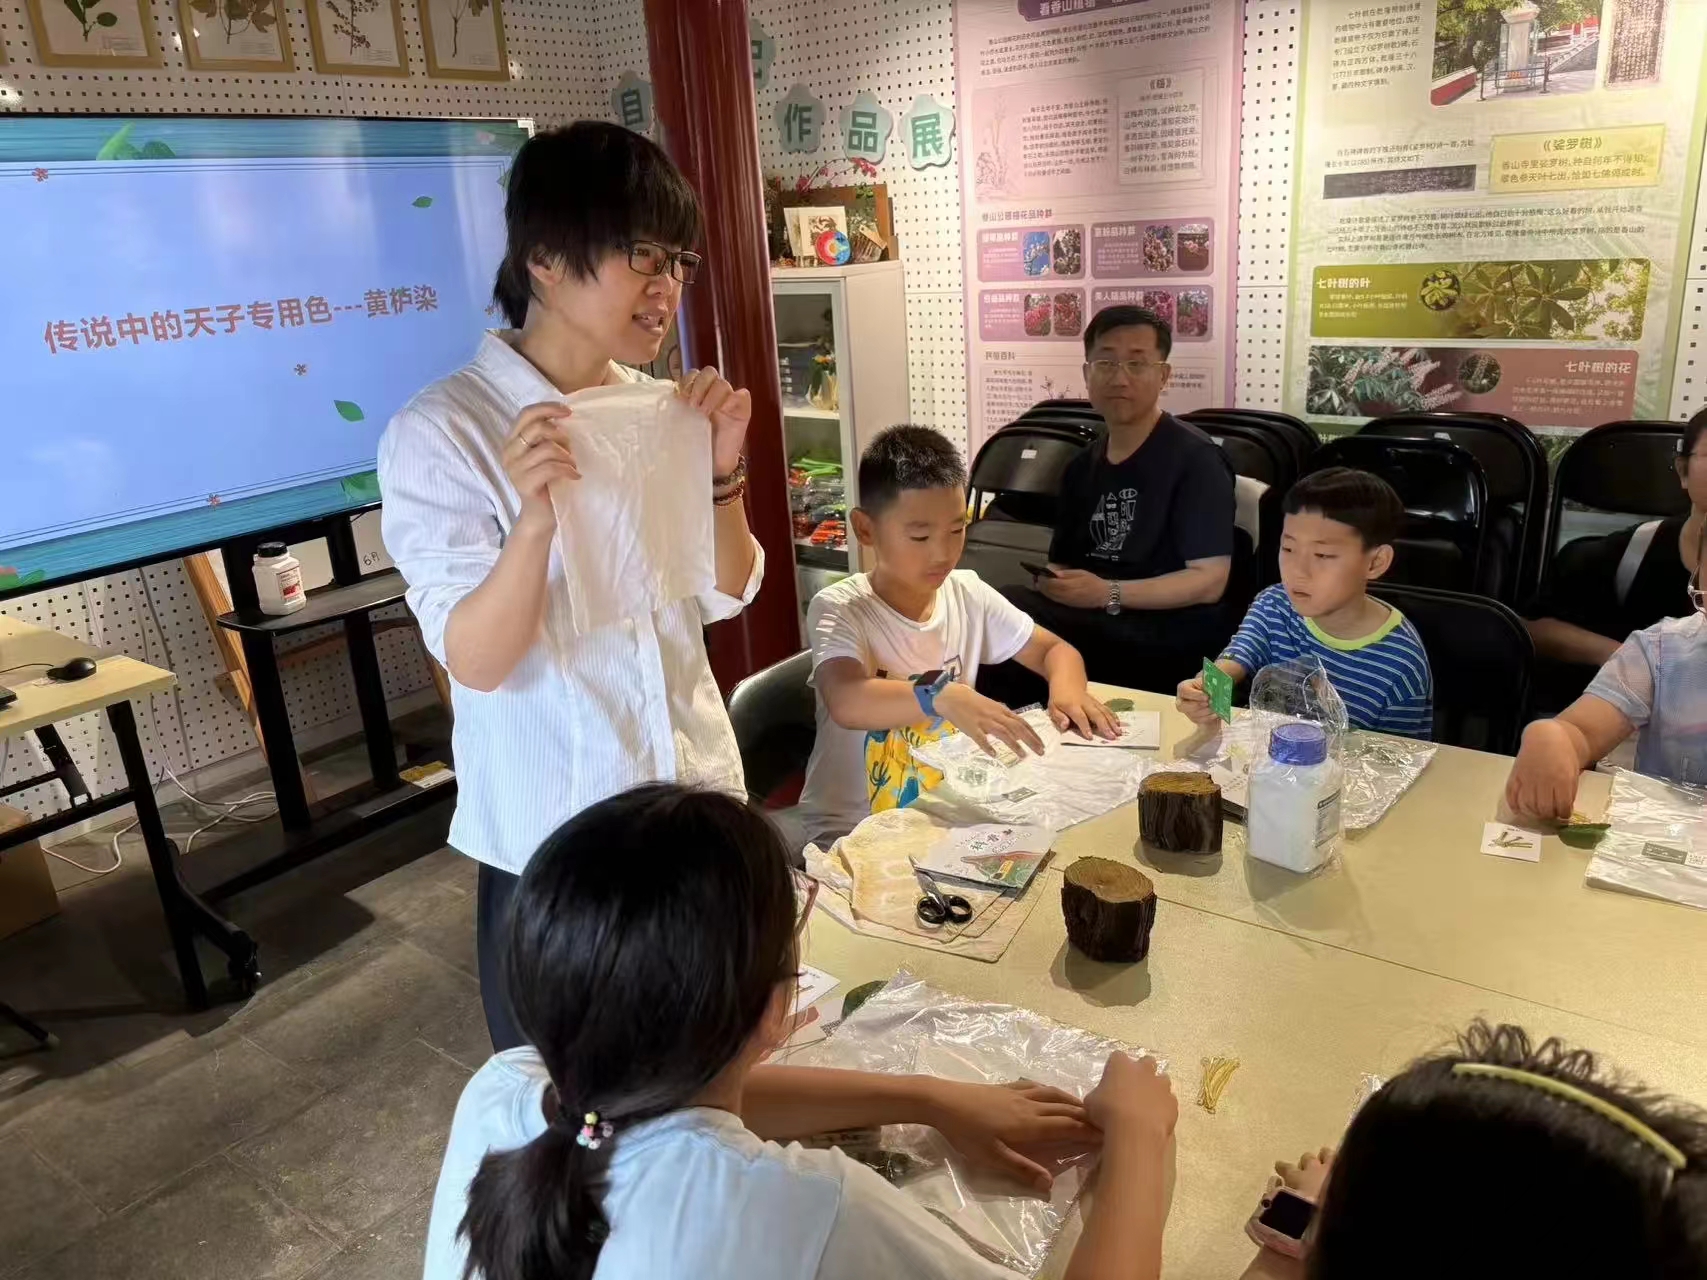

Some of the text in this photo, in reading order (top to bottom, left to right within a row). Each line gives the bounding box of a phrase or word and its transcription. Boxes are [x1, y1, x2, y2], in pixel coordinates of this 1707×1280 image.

[783, 102, 945, 158] 作品展
[1316, 277, 1371, 289] 七叶树的叶
[1565, 360, 1632, 374] 七叶树的花
